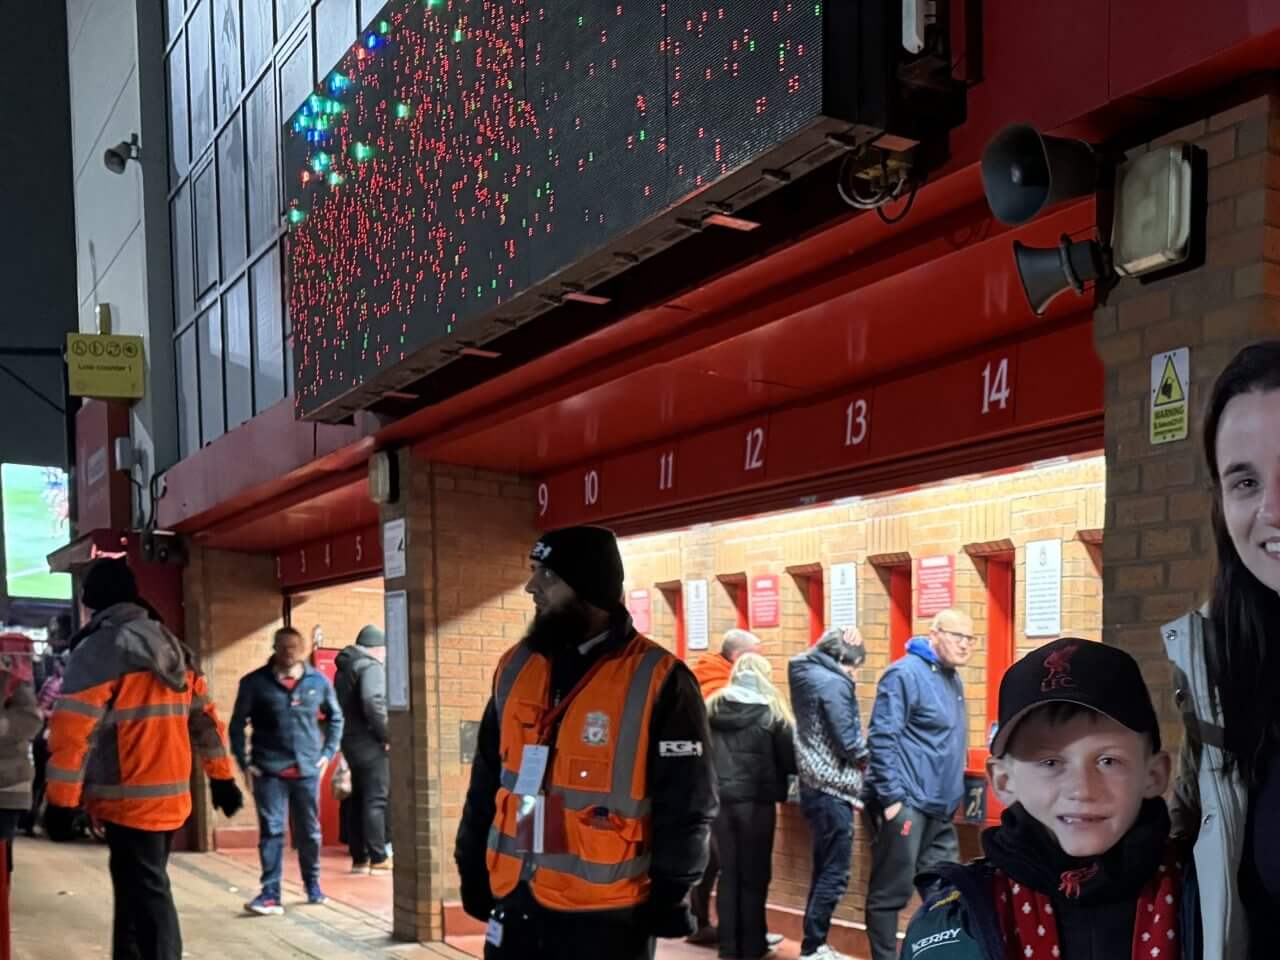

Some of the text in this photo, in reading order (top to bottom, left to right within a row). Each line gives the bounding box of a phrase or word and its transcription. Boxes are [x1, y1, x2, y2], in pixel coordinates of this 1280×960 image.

[981, 358, 1010, 415] 14
[844, 399, 867, 446] 13
[744, 427, 764, 471] 12
[584, 470, 598, 505] 10
[659, 452, 673, 490] 11
[538, 483, 549, 516] 9
[911, 927, 962, 953] KERRY
